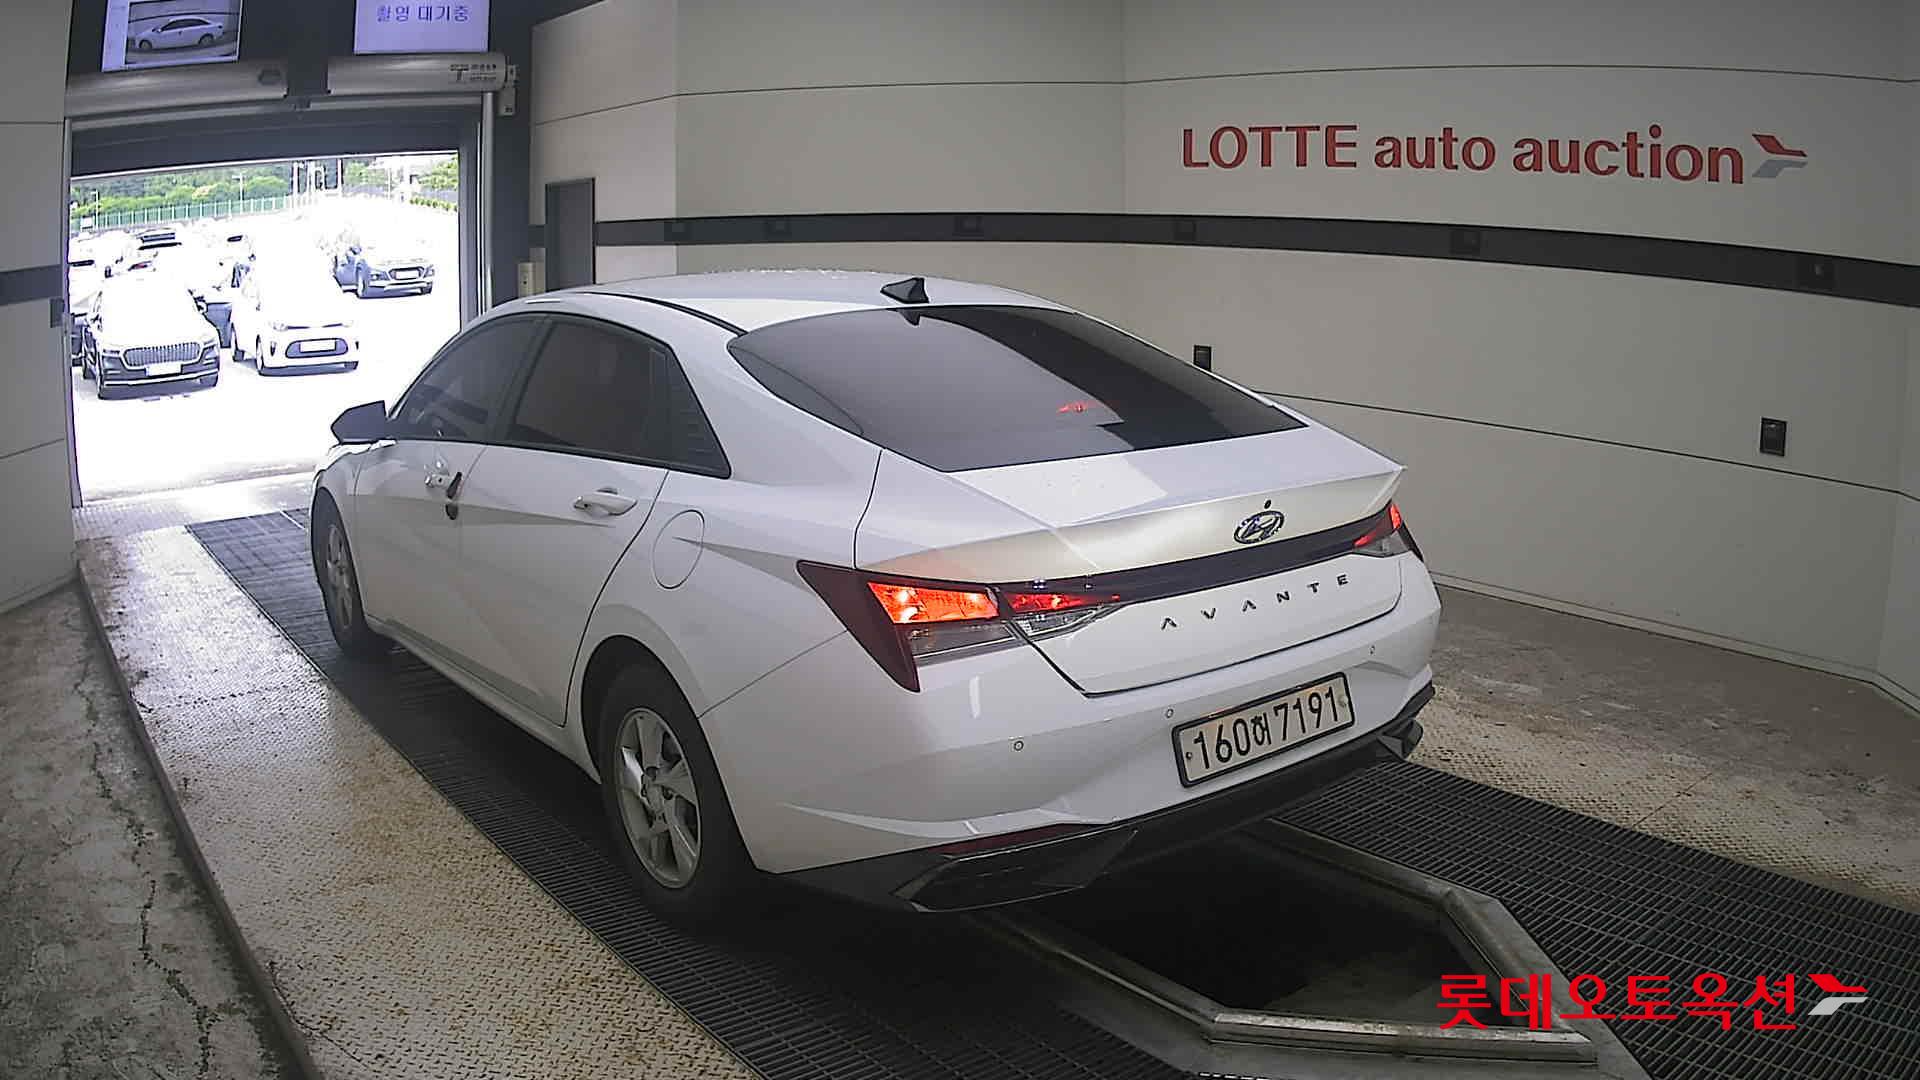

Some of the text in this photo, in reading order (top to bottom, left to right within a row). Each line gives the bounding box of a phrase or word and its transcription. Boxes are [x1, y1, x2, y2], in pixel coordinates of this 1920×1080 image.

[1183, 124, 1744, 184] LOTTE auto auction
[1160, 573, 1349, 631] AVANTE
[1193, 685, 1340, 770] 160허7191
